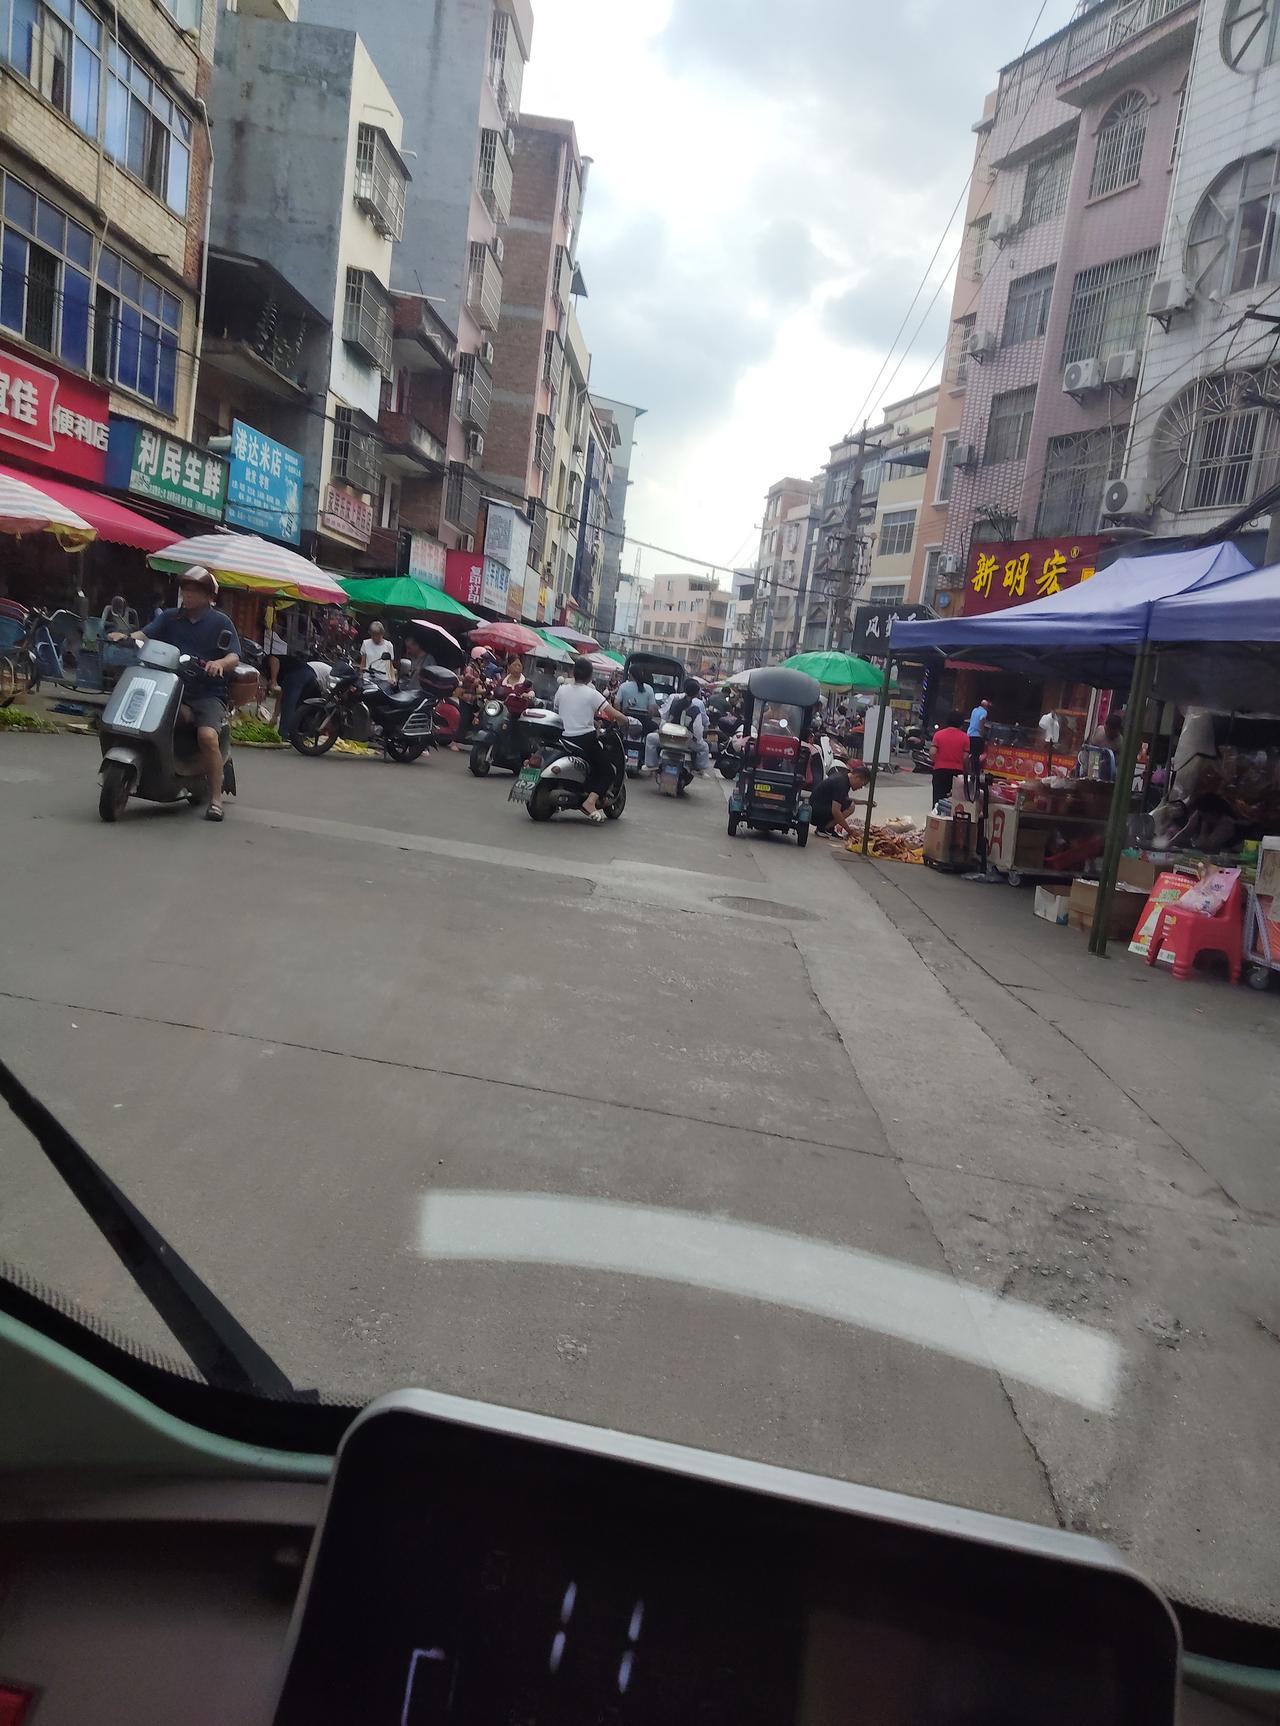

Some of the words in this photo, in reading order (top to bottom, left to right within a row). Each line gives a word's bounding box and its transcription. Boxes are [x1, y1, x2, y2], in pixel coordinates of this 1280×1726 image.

[53, 404, 110, 452] 便利店
[235, 427, 282, 478] 港达米店
[138, 429, 222, 501] 利民生鲜
[468, 565, 481, 604] 复印打印
[971, 548, 1066, 598] 新明宏
